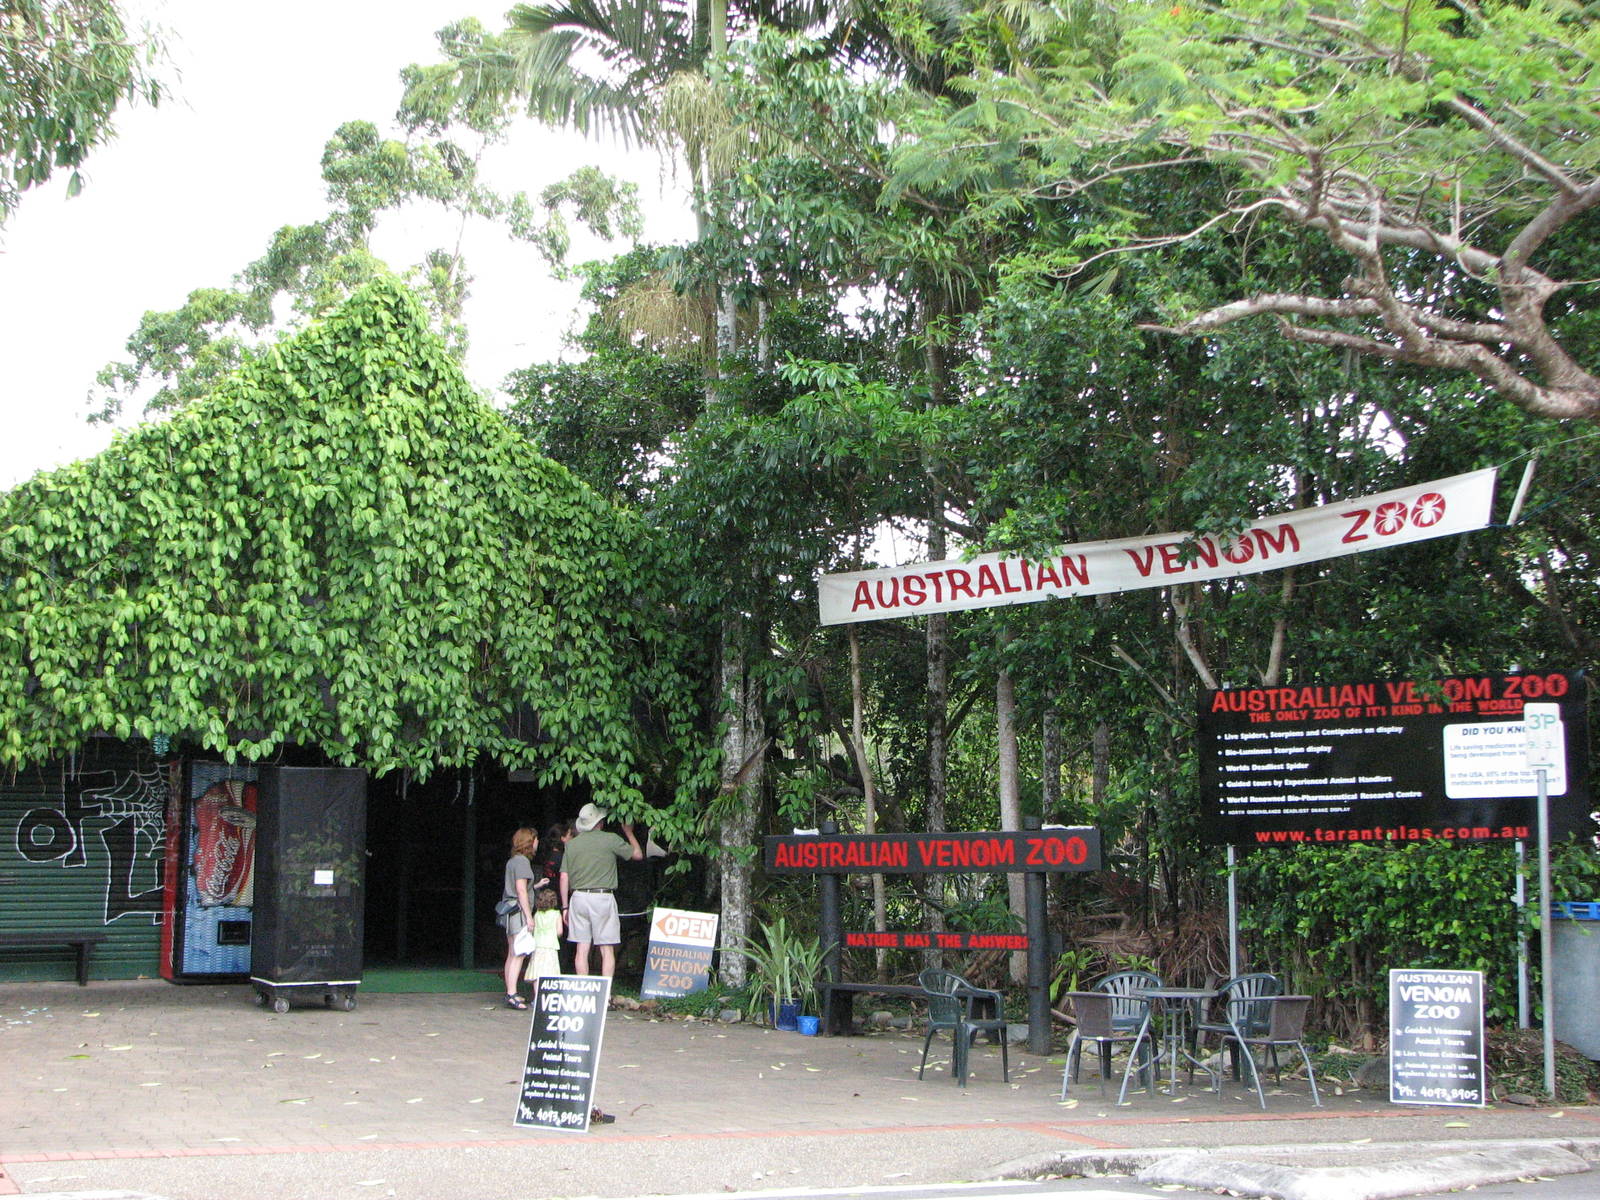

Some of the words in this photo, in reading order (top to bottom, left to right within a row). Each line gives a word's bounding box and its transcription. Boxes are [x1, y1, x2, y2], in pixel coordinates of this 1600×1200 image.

[852, 553, 1090, 612] AUSTRALIAN
[1122, 522, 1300, 577] VENOM
[1340, 492, 1447, 544] ZOO
[1211, 683, 1375, 712] AUSTRALIAN
[1386, 677, 1492, 704] VEOM
[1503, 673, 1569, 698] ZOO
[1249, 711, 1271, 723] THE
[1275, 710, 1309, 721] ONLY
[1313, 708, 1340, 720] ZOO
[1345, 707, 1362, 718] OF
[1391, 703, 1424, 716] KIND
[1450, 701, 1473, 713] THE
[1478, 698, 1524, 712] WORLD
[1528, 713, 1556, 729] 3P
[1270, 730, 1305, 739] Scorpions
[1321, 727, 1363, 736] Centipedes
[1376, 726, 1404, 734] display
[1462, 728, 1479, 736] DID
[1483, 726, 1504, 735] YOU
[1274, 746, 1305, 755] Scorpion
[1306, 745, 1333, 754] display
[1251, 763, 1285, 771] Deadliest
[1286, 762, 1309, 771] Spider
[1226, 780, 1251, 788] Guided
[1273, 779, 1283, 788] by
[1284, 778, 1328, 787] Experienced
[1330, 776, 1356, 784] Animal
[1358, 775, 1393, 783] Handlers
[1226, 796, 1248, 804] World
[1249, 795, 1286, 803] Renowned
[1360, 791, 1394, 800] Research
[1255, 824, 1530, 843] www.tarantulas.com.au
[774, 842, 908, 869] AUSTRALIAN
[918, 839, 1015, 868] VENOM
[1025, 836, 1088, 867] ZOO
[664, 916, 715, 940] OPEN
[847, 933, 898, 948] NATURE
[904, 933, 931, 948] HAS
[938, 934, 962, 948] THE
[650, 946, 710, 961] AUSTRALIAN
[649, 957, 710, 976] VENOM
[541, 979, 601, 993] AUSTRALIAN
[656, 974, 693, 990] ZOO
[1396, 974, 1472, 985] AUSTRALIAN
[1400, 985, 1472, 1004] VENOM
[541, 993, 597, 1014] VENOM
[1414, 1004, 1460, 1019] ZOO
[546, 1014, 584, 1032] ZOO
[1405, 1025, 1432, 1034] Guided
[537, 1039, 557, 1050] Guided
[1443, 1037, 1465, 1047] Tours
[542, 1051, 562, 1061] Animal
[564, 1053, 582, 1063] Tours
[560, 1111, 585, 1126] 8905
